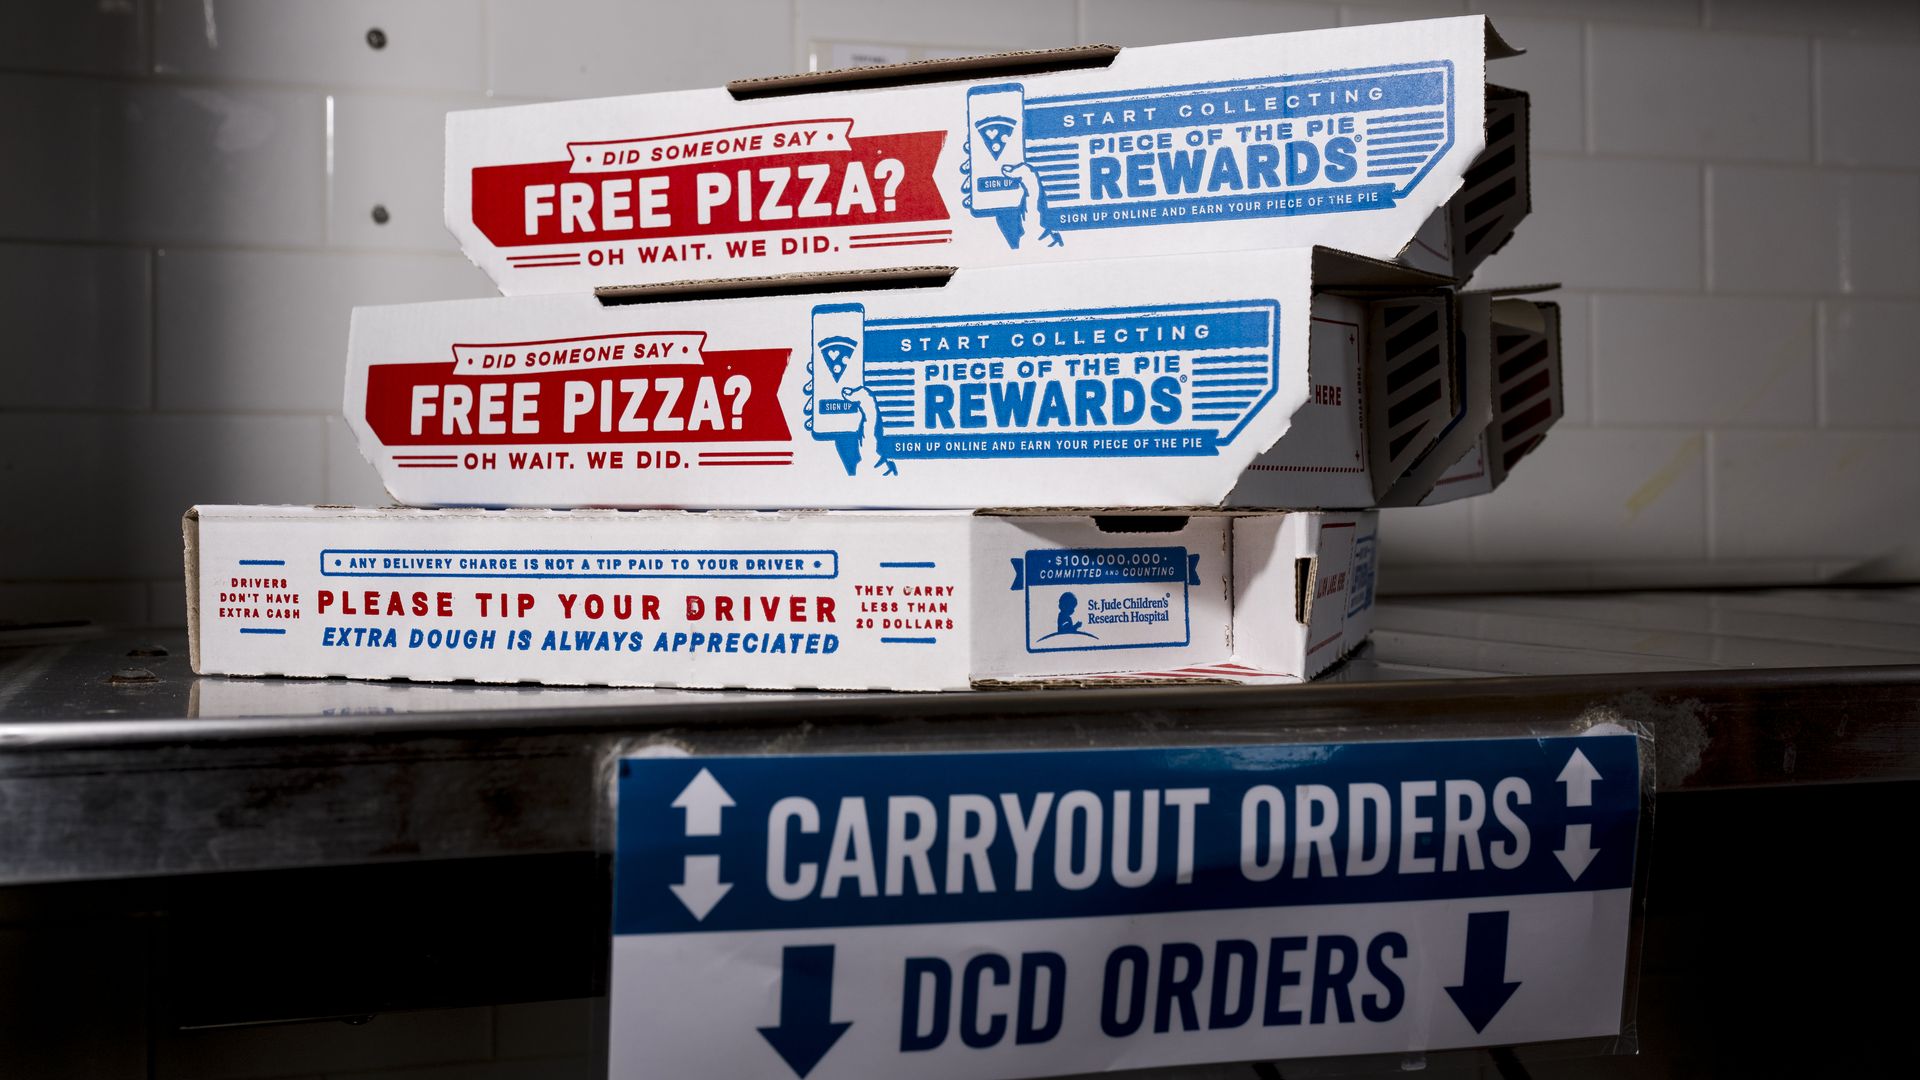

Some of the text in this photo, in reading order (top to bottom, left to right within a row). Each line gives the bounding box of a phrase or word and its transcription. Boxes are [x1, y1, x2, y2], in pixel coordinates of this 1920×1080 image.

[1063, 86, 1384, 128] START COLLECTING
[1089, 116, 1356, 155] PIECE OF THE PIE
[602, 130, 818, 166] DID SOMEONE SAY
[984, 180, 1001, 188] SIGN
[524, 158, 905, 236] FREE PIZZA?
[1059, 192, 1378, 224] SIGN UP ONLINE AND EARN YOUR PIECE OF THE PIE
[587, 236, 839, 267] OH WAIT. WE DID.
[901, 325, 1210, 352] START COLLECTING
[482, 343, 674, 369] DID SOMEONE SAY
[924, 355, 1181, 381] PIECE OF THE PIE
[410, 374, 752, 436] FREE PIZZA?
[1315, 384, 1342, 406] HERE
[825, 403, 841, 411] SIGN
[895, 438, 1202, 452] SIGN UP ONLINE AND EARN YOUR PIECE OF THE PIE
[464, 451, 689, 470] OH WAIT. WE DID.
[350, 558, 805, 570] ANY DELIVERY CHARGE IS NOT A TIP PAID TO YOUR DRIVER
[1055, 554, 1161, 566] $100,000,000
[1040, 568, 1102, 579] COMMITTED
[1122, 566, 1176, 577] COUNTING
[231, 578, 288, 589] DRIVERS
[854, 585, 955, 597] THEY CARRY
[220, 592, 300, 605] DON'T HAVE
[317, 590, 837, 623] PLEASE TIP YOUR DRIVER
[861, 602, 948, 613] LESS THAN
[1088, 599, 1100, 611] St.
[1100, 598, 1122, 613] Jude
[219, 607, 300, 619] EXTRA CASH
[1088, 610, 1169, 625] Research Hospital
[856, 618, 954, 630] 20 DOLLARS
[322, 627, 839, 655] EXTRA DOUGH IS ALWAYS APPRECIATED
[765, 775, 1534, 903] CARRYOUT ORDERS
[898, 930, 1409, 1053] DCD ORDERS
